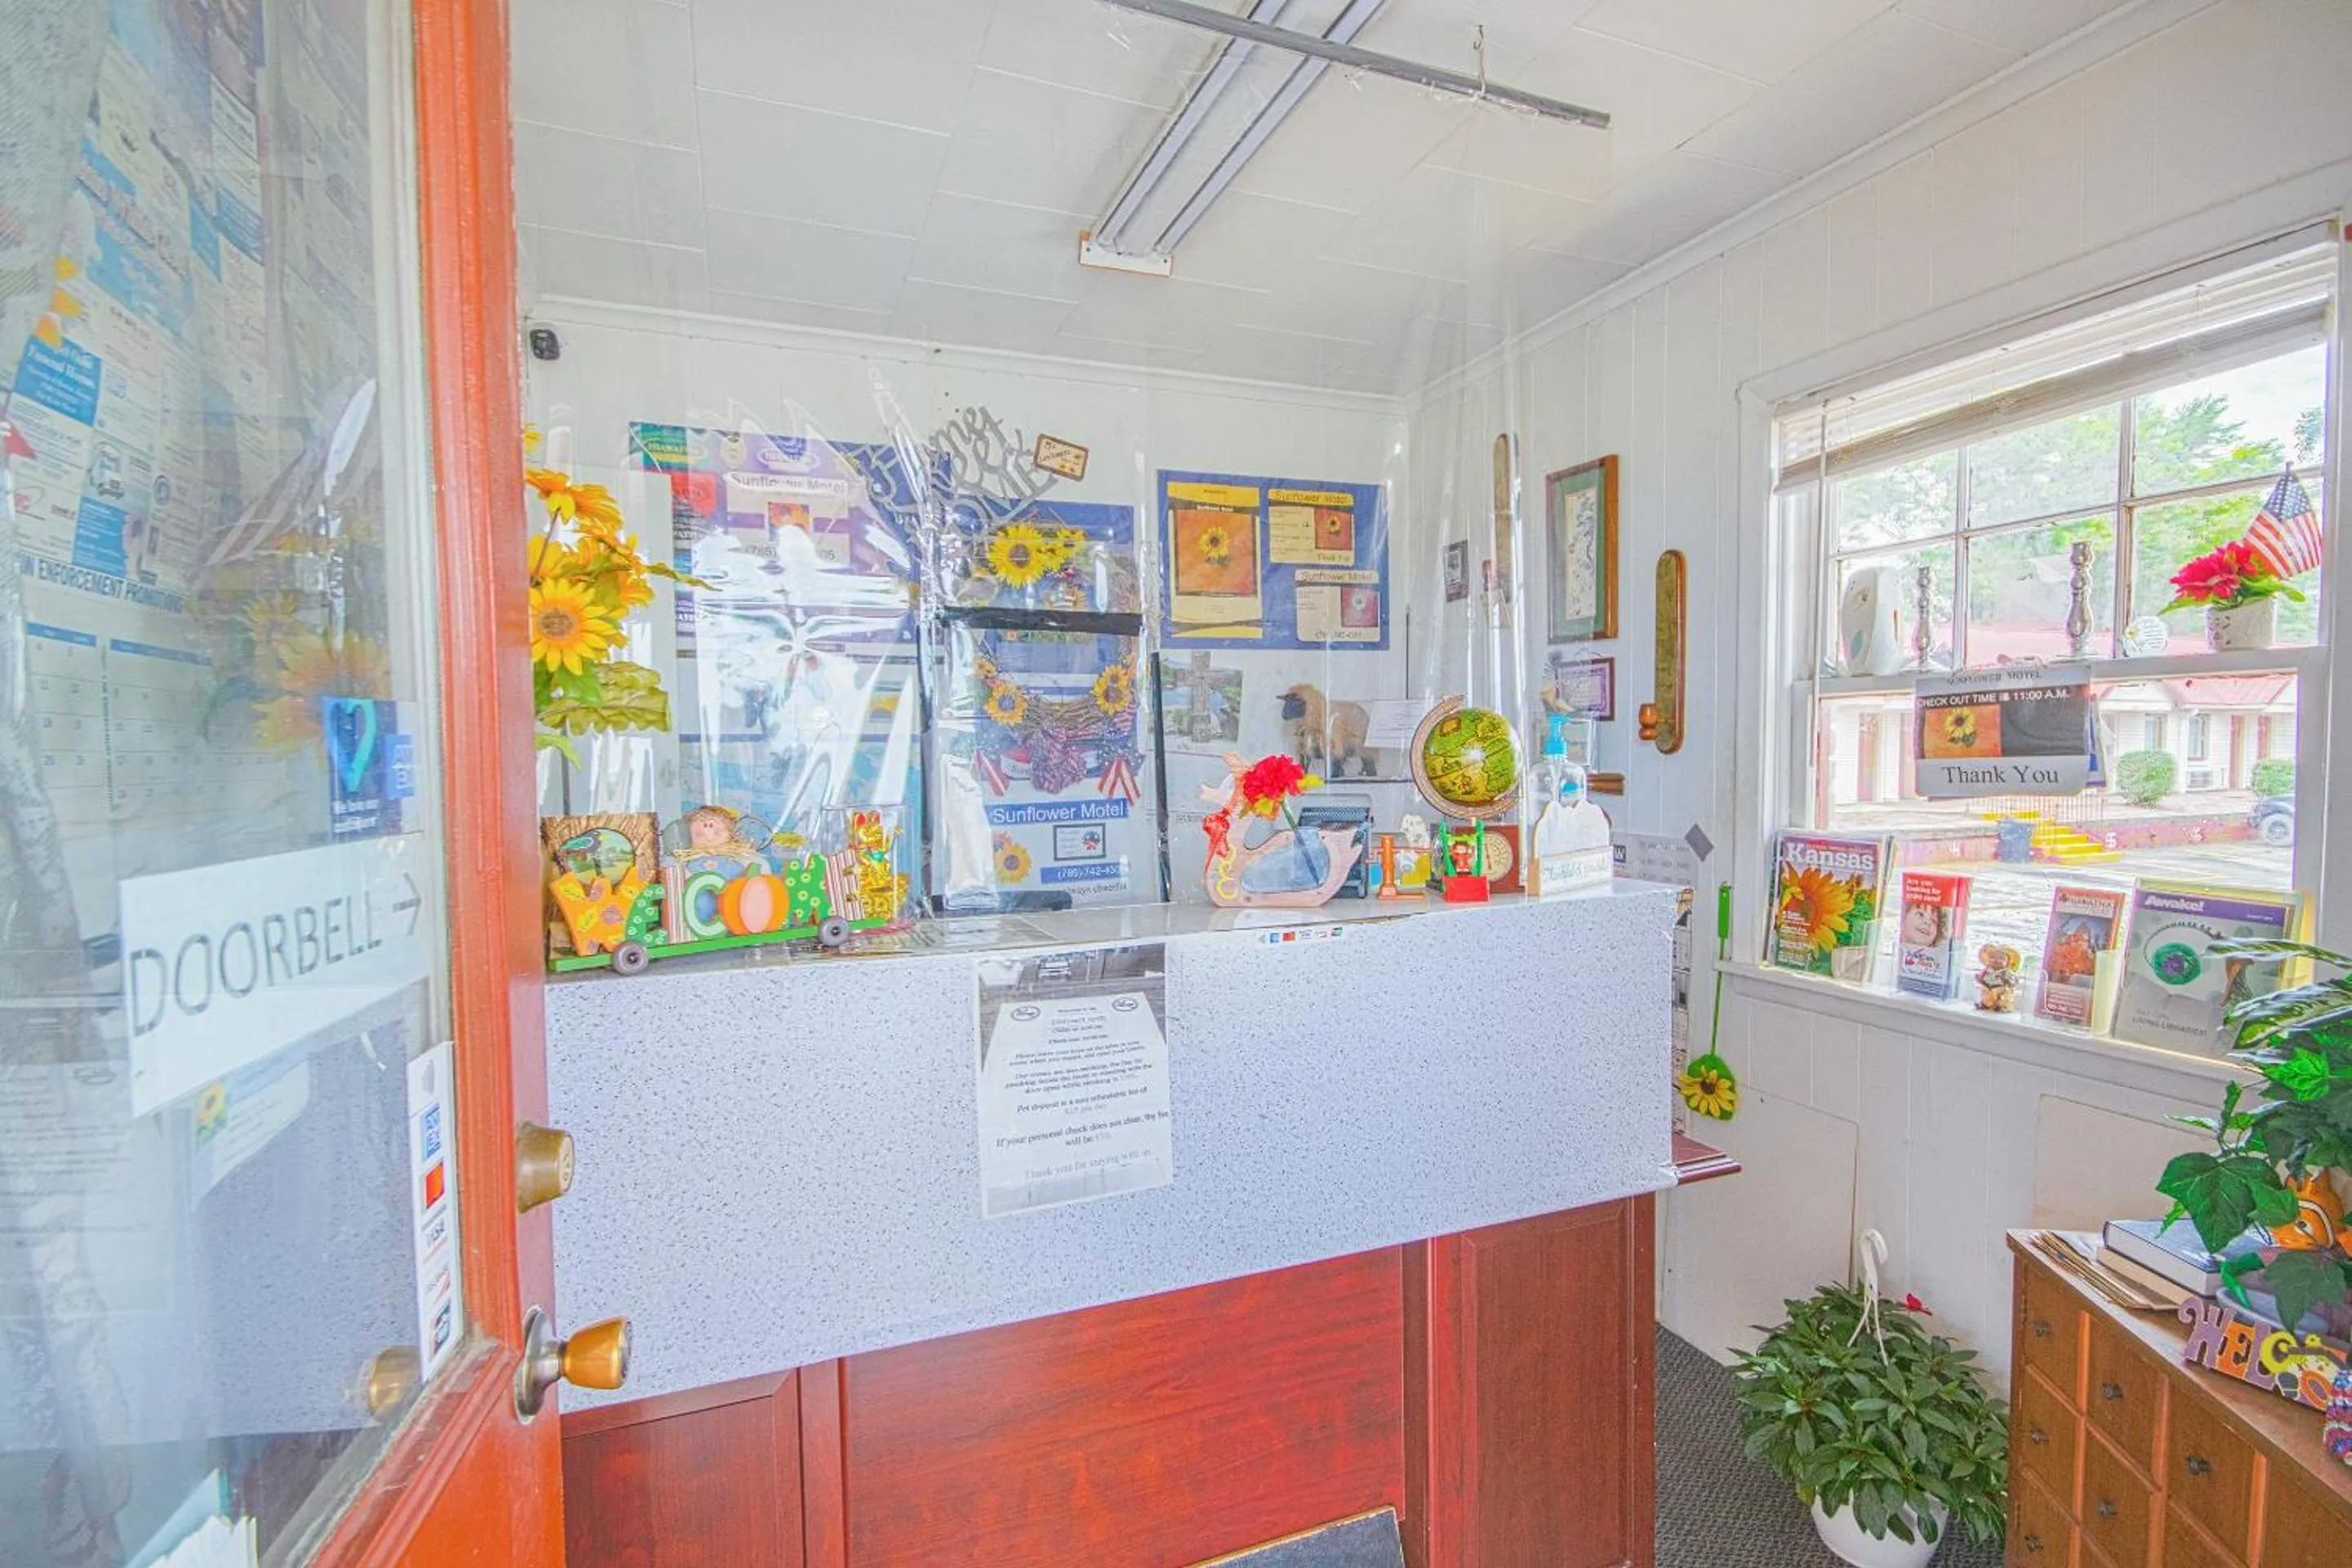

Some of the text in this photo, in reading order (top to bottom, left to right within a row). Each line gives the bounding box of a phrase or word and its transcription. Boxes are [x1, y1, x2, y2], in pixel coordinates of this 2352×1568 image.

[1275, 490, 1320, 502] Sunflower
[2007, 670, 2042, 680] MOTEL
[1918, 697, 1949, 708] CHECK
[1950, 695, 1970, 706] OUT
[1972, 693, 1997, 704] TIME
[2013, 690, 2042, 702] 11:00
[2043, 688, 2070, 700] A.M.
[1940, 766, 2059, 785] Thank You
[992, 802, 1125, 824] Sunflower Motel
[1786, 841, 1874, 871] Kansas
[2143, 894, 2205, 912] Awake!
[130, 889, 384, 1037] DOORBELL
[996, 1138, 1004, 1147] If
[1028, 1128, 1063, 1143] personal
[1064, 1124, 1088, 1136] check
[1089, 1121, 1108, 1132] does
